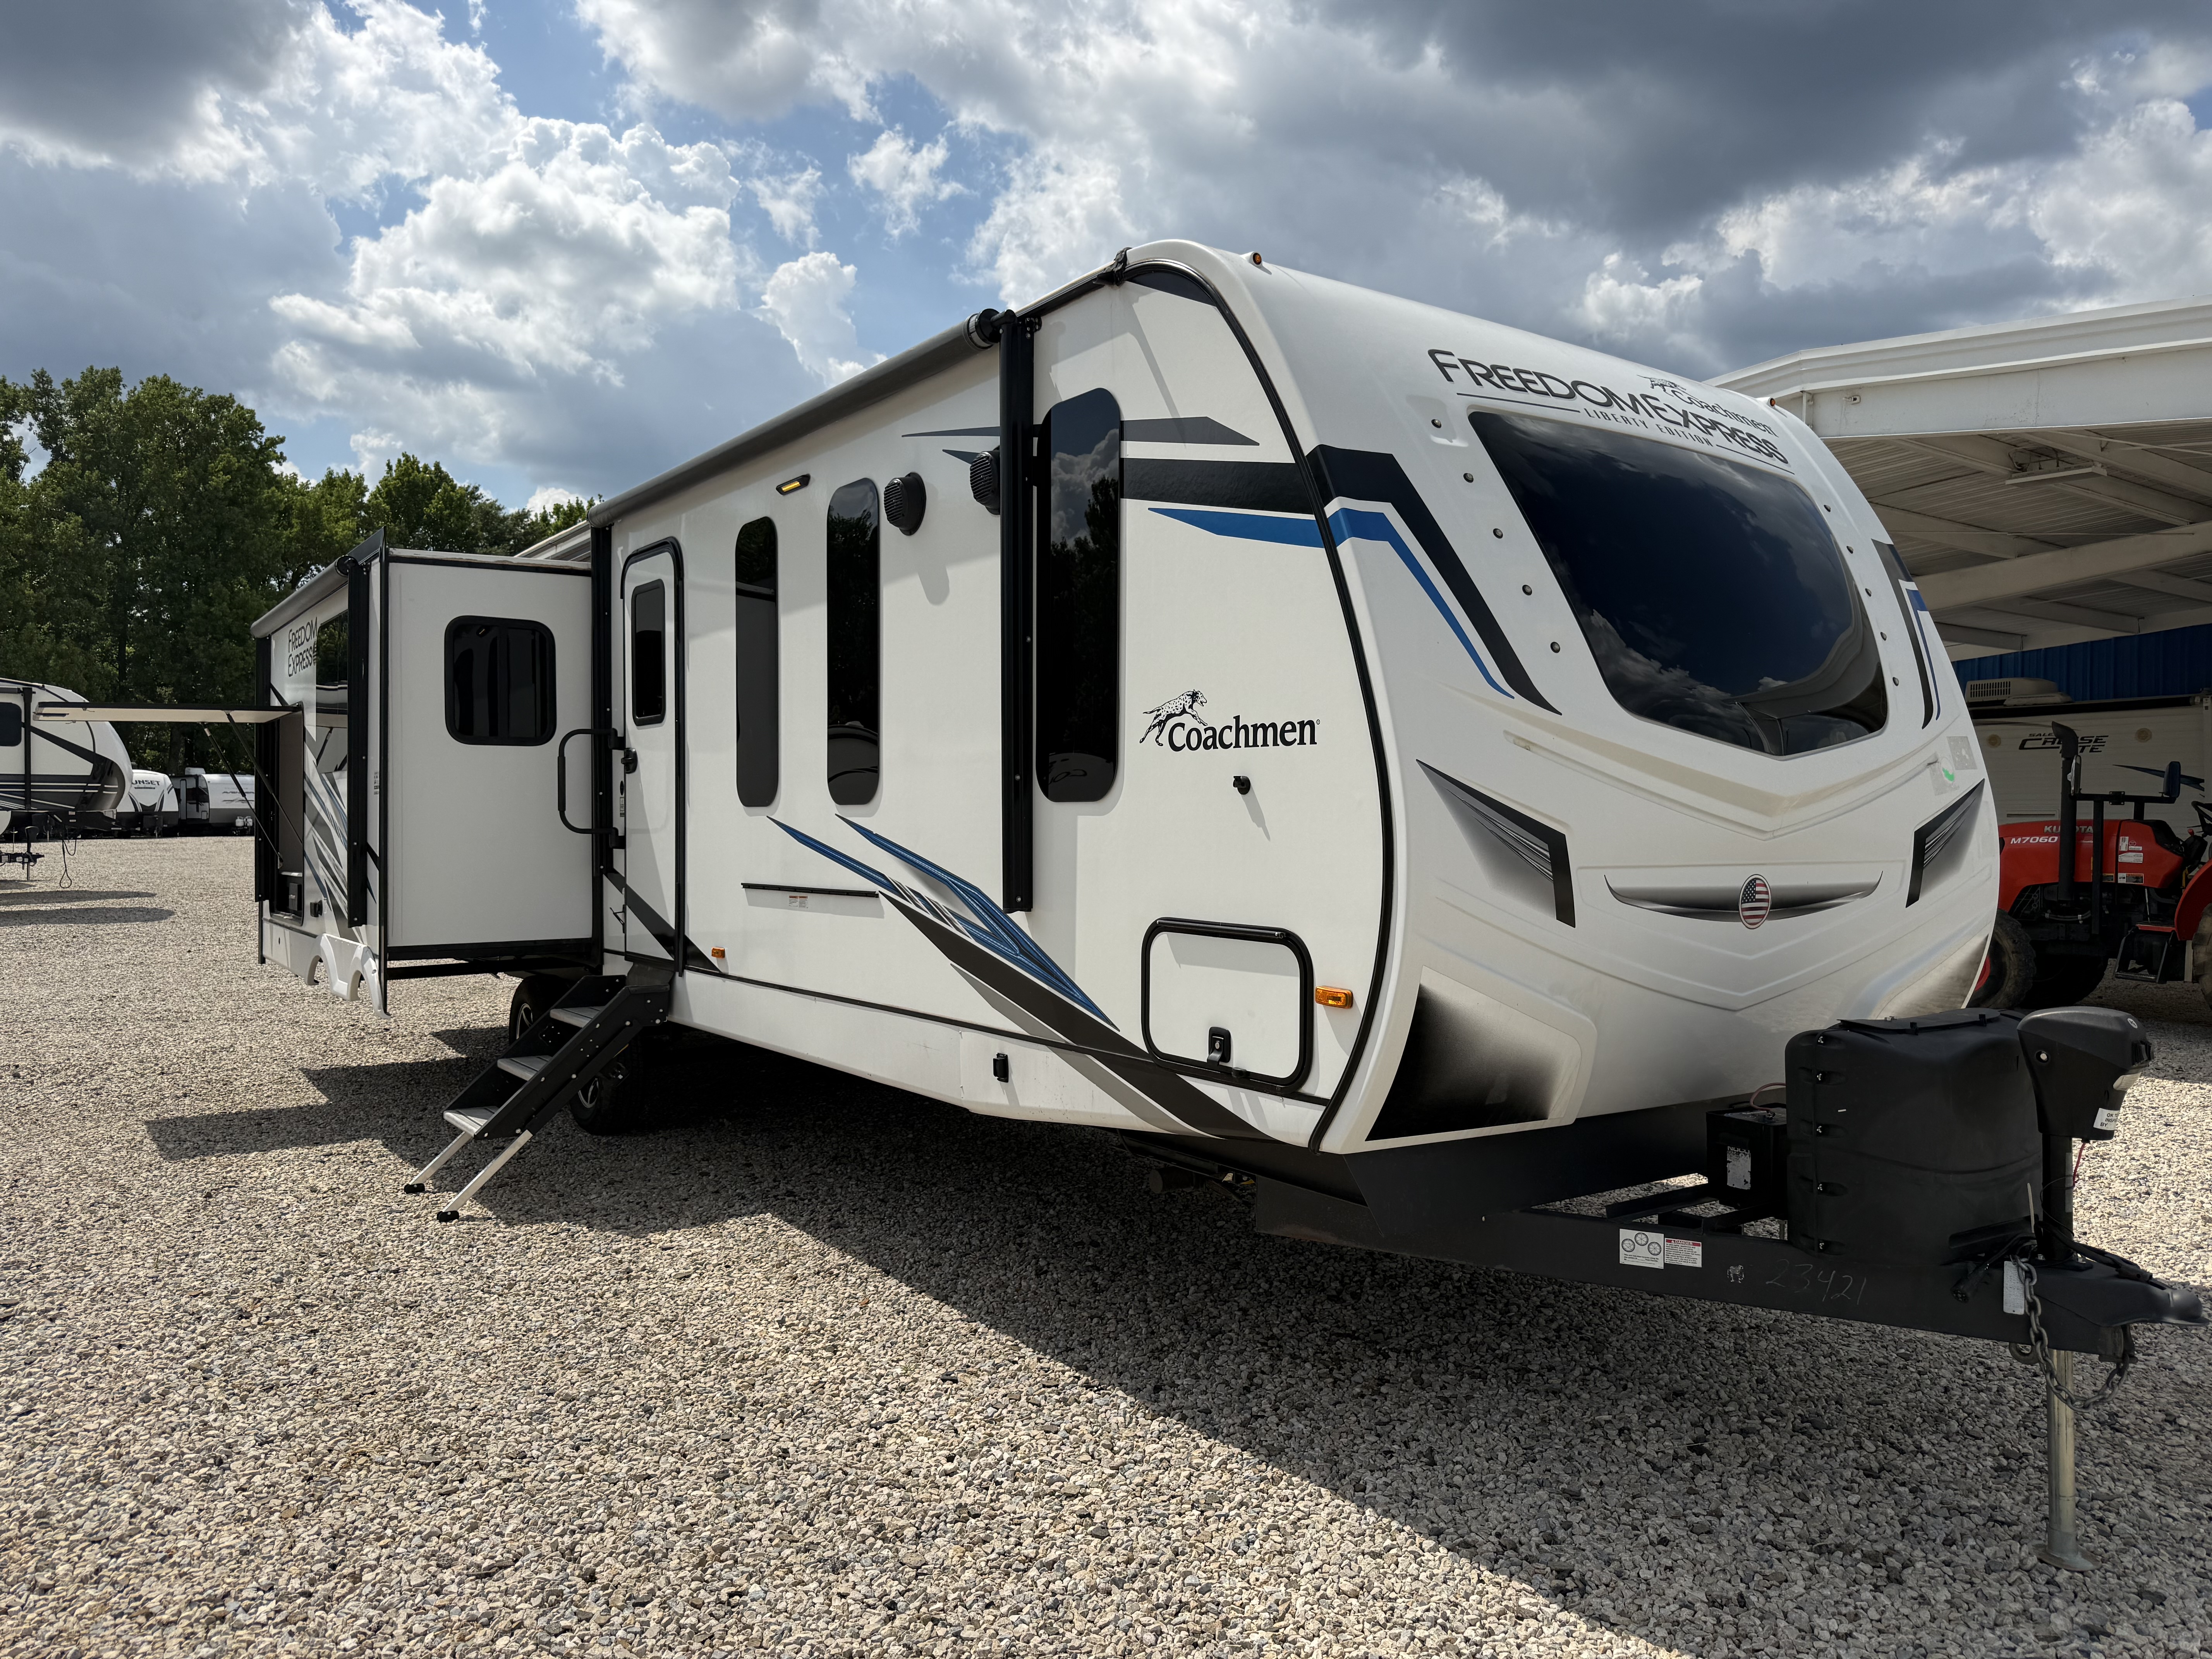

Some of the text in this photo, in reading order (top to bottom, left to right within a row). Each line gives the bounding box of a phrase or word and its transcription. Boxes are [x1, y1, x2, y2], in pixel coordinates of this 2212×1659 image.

[1583, 408, 1714, 447] LIBERTY EDITION
[1671, 389, 1779, 438] Coachmen
[289, 616, 318, 653] FREEDOM
[288, 646, 313, 677] EXPRESS
[2019, 735, 2109, 750] CRSE
[2010, 836, 2058, 844] M7060
[2044, 825, 2094, 833] KUTA
[1765, 1259, 1867, 1305] 23421
